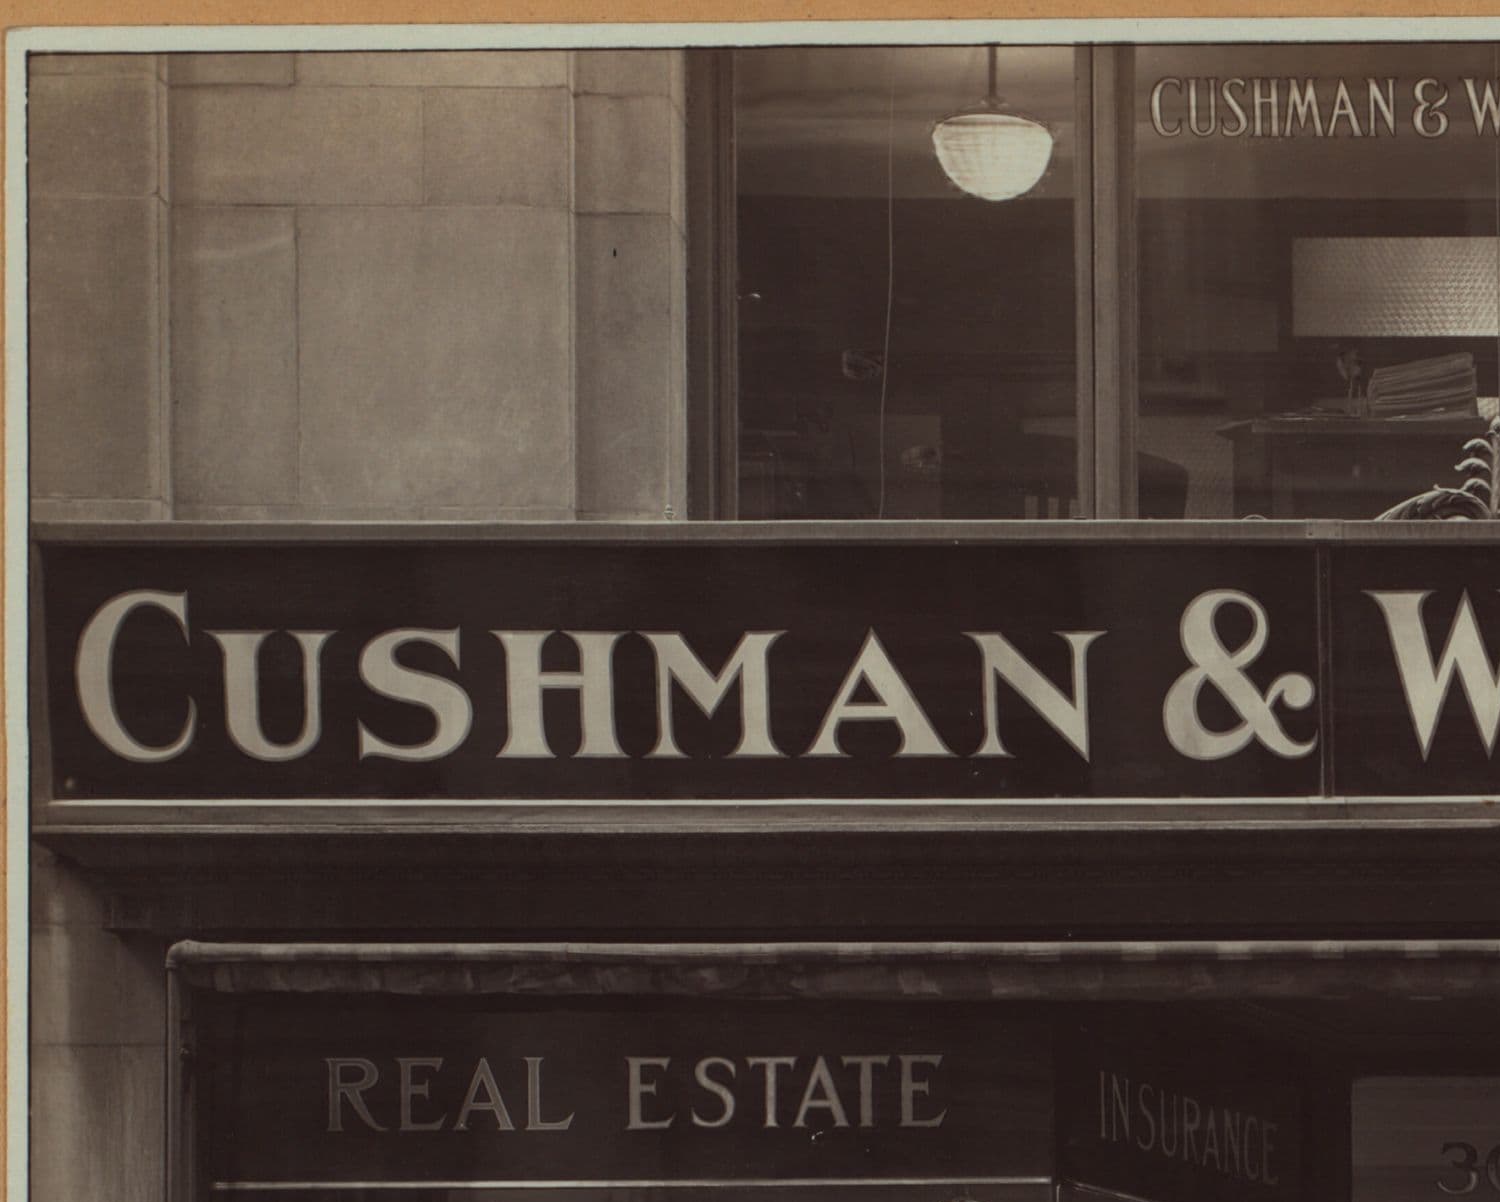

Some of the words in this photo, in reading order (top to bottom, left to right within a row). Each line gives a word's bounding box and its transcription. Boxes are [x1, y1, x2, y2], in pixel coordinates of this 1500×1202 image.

[1148, 76, 1398, 139] CUSHMAN
[1411, 76, 1450, 139] &
[74, 586, 1109, 763] CUSHMAN
[1162, 587, 1318, 761] &
[325, 1055, 575, 1133] REAL
[625, 1054, 948, 1131] ESTATE
[1098, 1068, 1280, 1187] INSURANCE
